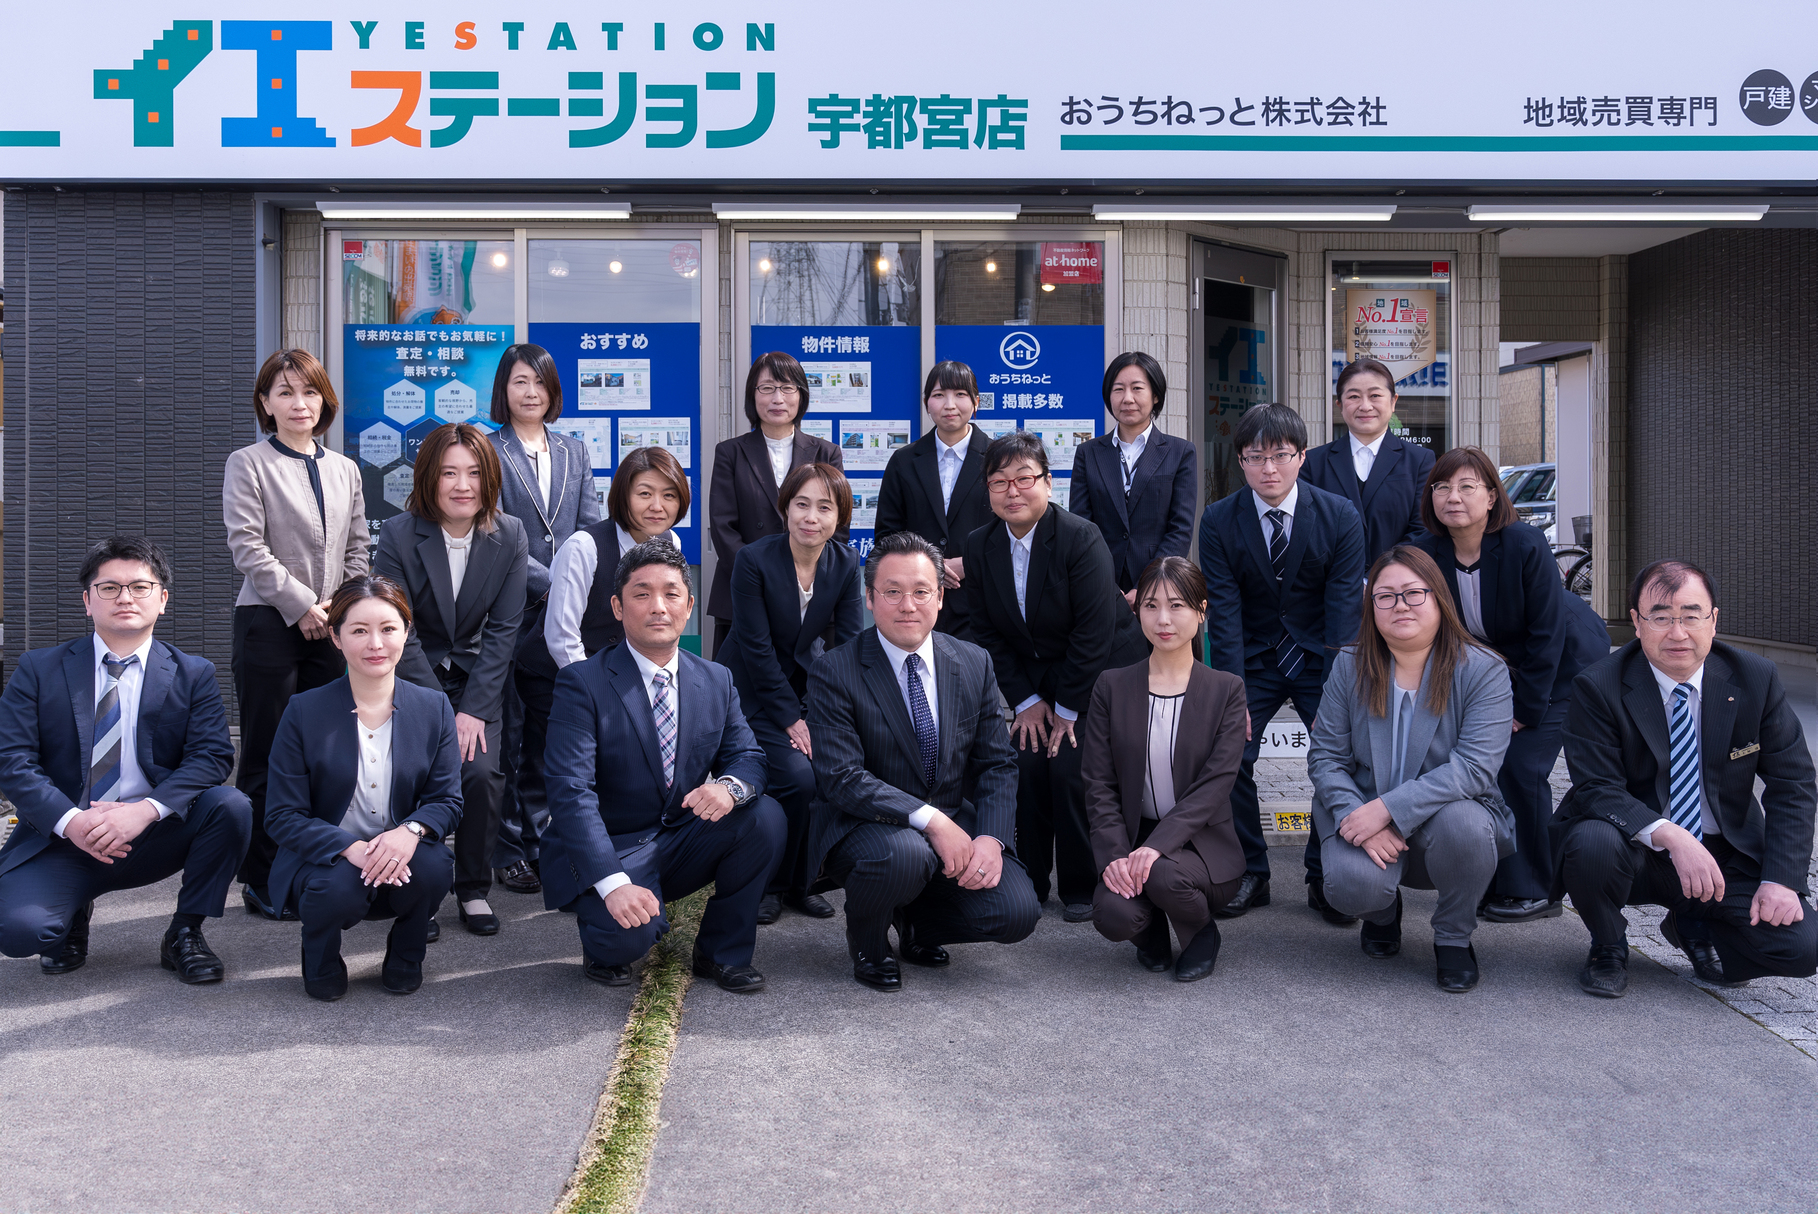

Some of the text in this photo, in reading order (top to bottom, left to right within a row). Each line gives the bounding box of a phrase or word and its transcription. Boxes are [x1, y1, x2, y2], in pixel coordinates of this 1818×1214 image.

[350, 21, 776, 51] YESTATION
[1743, 85, 1792, 110] 戸建
[351, 70, 776, 148] ステーション
[1060, 95, 1388, 127] おうちねっと株式会社
[1523, 96, 1718, 127] 地域売買専門
[807, 94, 1029, 150] 宇都宮店
[355, 330, 505, 342] 将来的なお話でもお気軽に！
[580, 333, 649, 350] おすすめ
[802, 336, 870, 353] 物件情報
[396, 347, 464, 360] 査定・相談
[403, 365, 457, 377] 無料です。
[989, 373, 1051, 384] おうちねっと
[1209, 383, 1266, 395] YESTATION
[1002, 393, 1064, 409] 掲載多数
[1391, 428, 1410, 436] 時間
